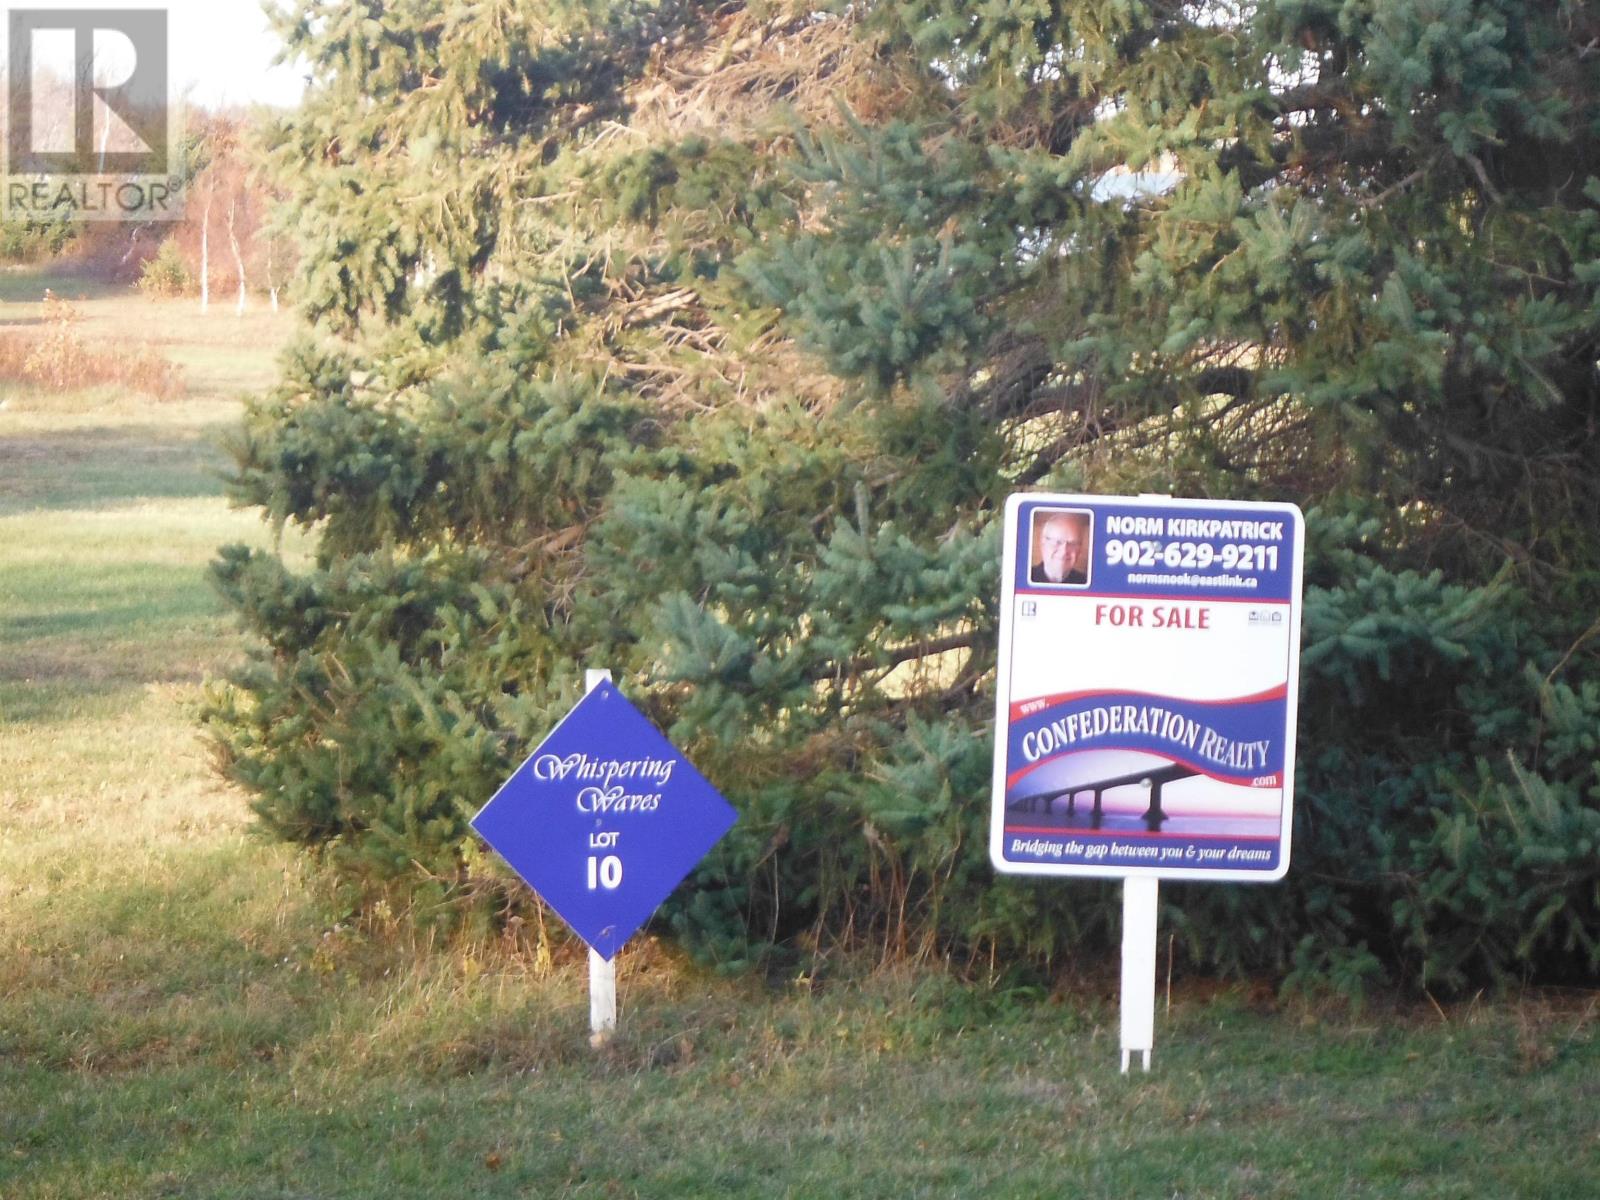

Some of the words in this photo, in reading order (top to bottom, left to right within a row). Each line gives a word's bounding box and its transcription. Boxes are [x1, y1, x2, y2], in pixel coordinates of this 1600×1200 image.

[1106, 516, 1164, 536] NORM
[1167, 518, 1283, 540] KIRKPATRICK
[1105, 539, 1278, 571] 902-629-9211
[1096, 604, 1144, 627] FOR
[1152, 606, 1210, 629] SALE
[1022, 705, 1201, 762] CONFEDERATION
[1198, 727, 1270, 770] REALTY
[533, 753, 676, 788] Whispering
[576, 785, 662, 812] Waves
[589, 832, 620, 848] LOT
[1011, 838, 1063, 857] Bridging
[1064, 840, 1084, 855] the
[1085, 844, 1108, 858] gap
[1110, 842, 1159, 857] between
[1159, 846, 1183, 861] you
[1185, 844, 1196, 858] &
[1196, 847, 1226, 862] your
[1227, 845, 1271, 861] dreams
[587, 855, 623, 890] 10
